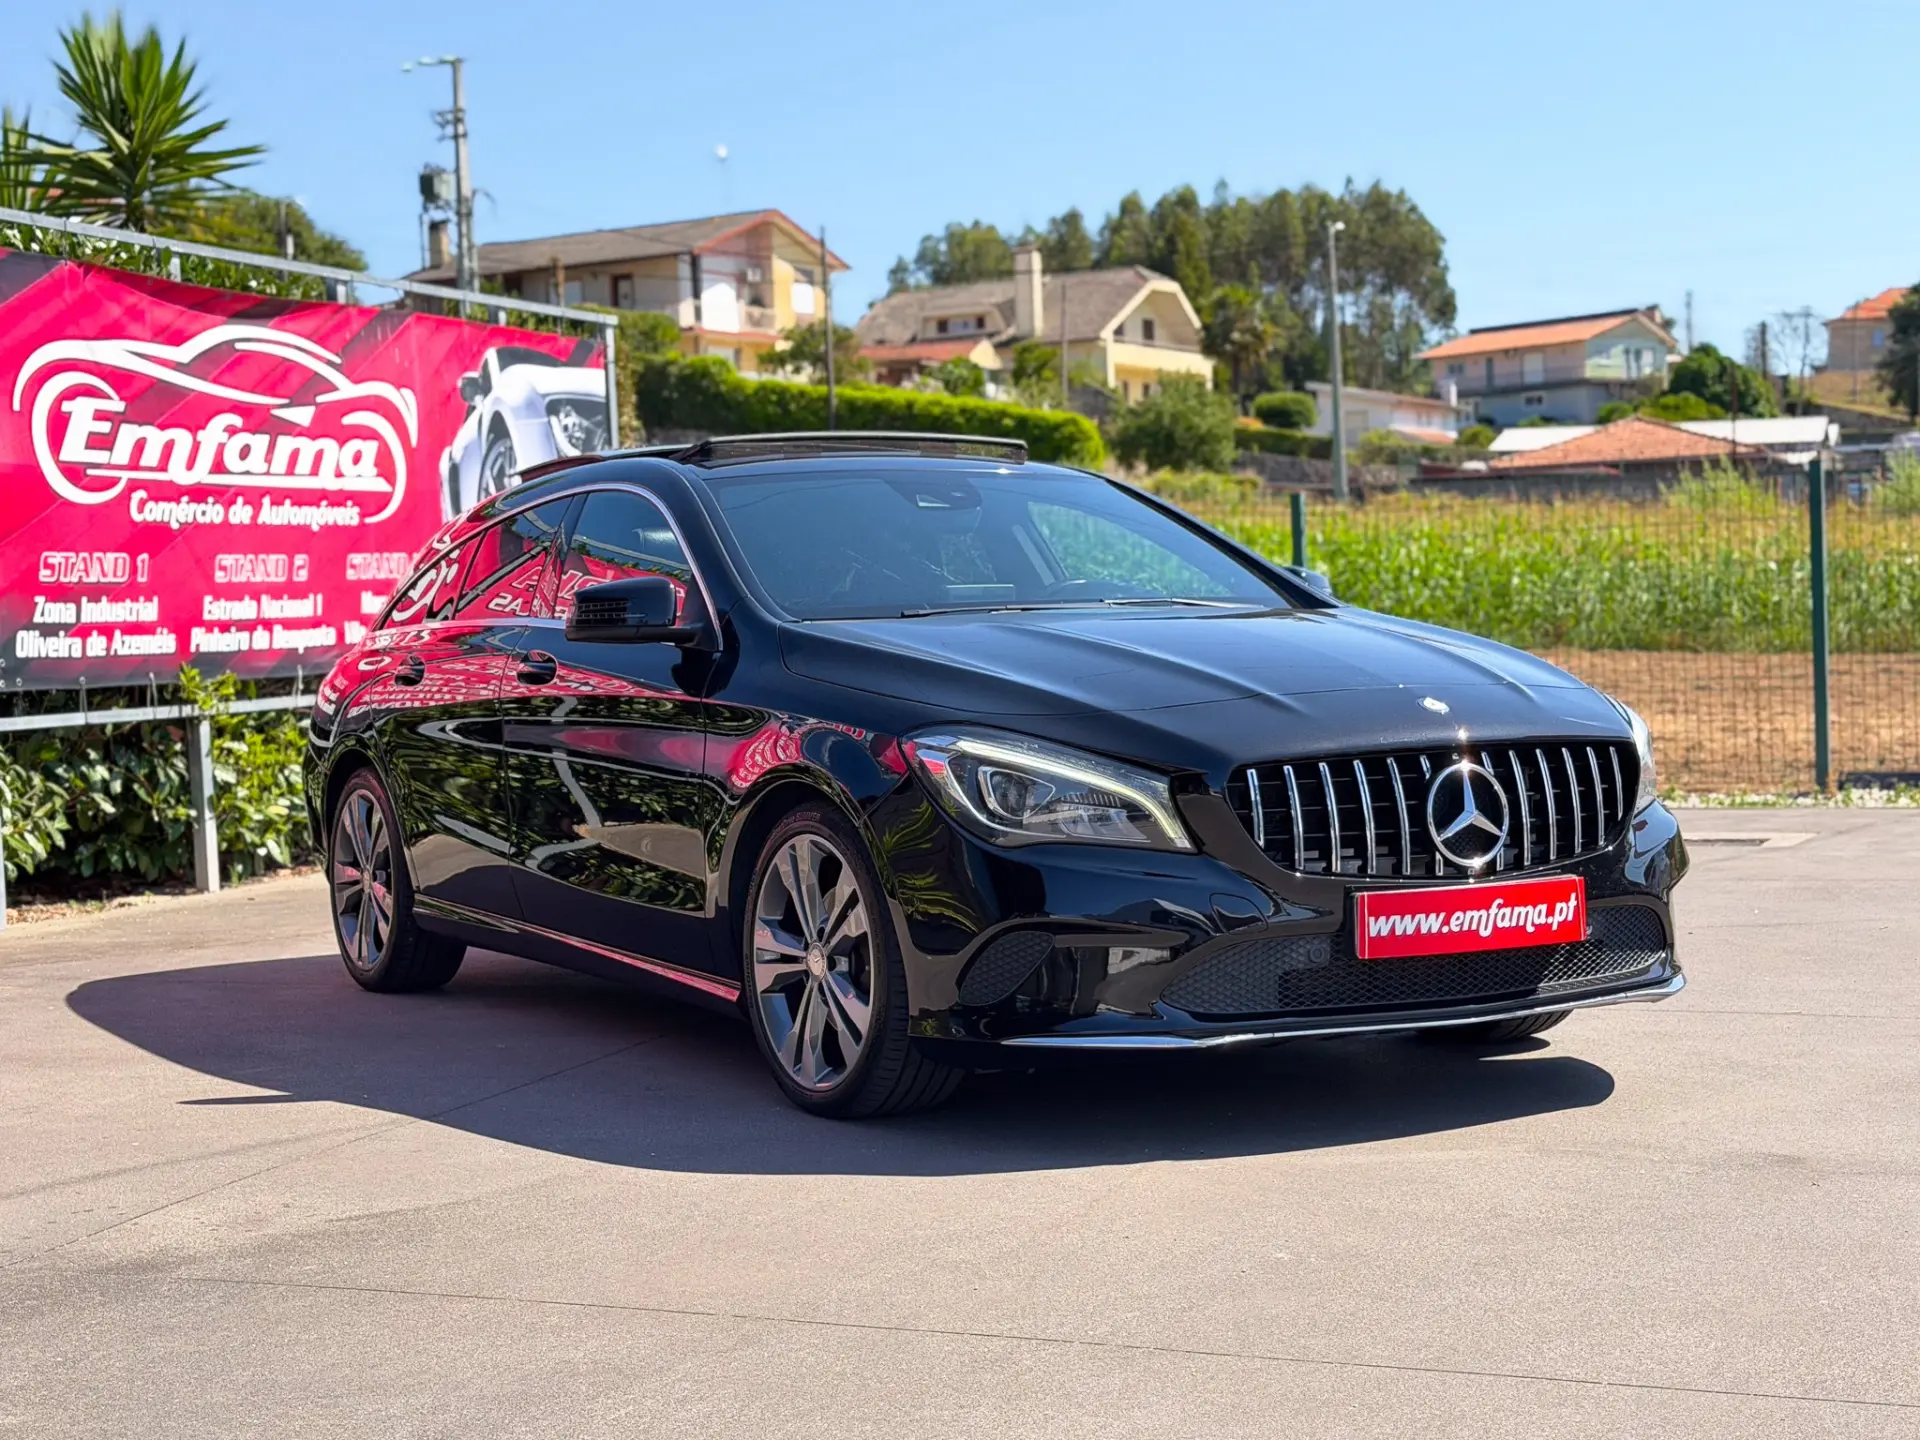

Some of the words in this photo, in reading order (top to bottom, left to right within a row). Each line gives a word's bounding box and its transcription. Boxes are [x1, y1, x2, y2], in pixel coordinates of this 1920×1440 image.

[58, 397, 379, 490] Emfama
[130, 491, 222, 530] Comércio
[228, 496, 253, 525] de
[258, 494, 361, 532] Automóveis
[39, 552, 129, 584] STAND
[137, 553, 149, 583] 1
[214, 553, 289, 583] STAND
[293, 553, 309, 582] 2
[33, 596, 76, 624] Zona
[81, 596, 158, 624] Industrial
[203, 594, 258, 621] Estrada
[260, 594, 315, 620] Nacional
[15, 630, 82, 659] Oliveira
[86, 630, 107, 657] de
[110, 627, 176, 656] Azeméis
[190, 626, 250, 653] Pinheiro
[252, 625, 270, 651] da
[1368, 893, 1577, 938] www.emfama.pt
